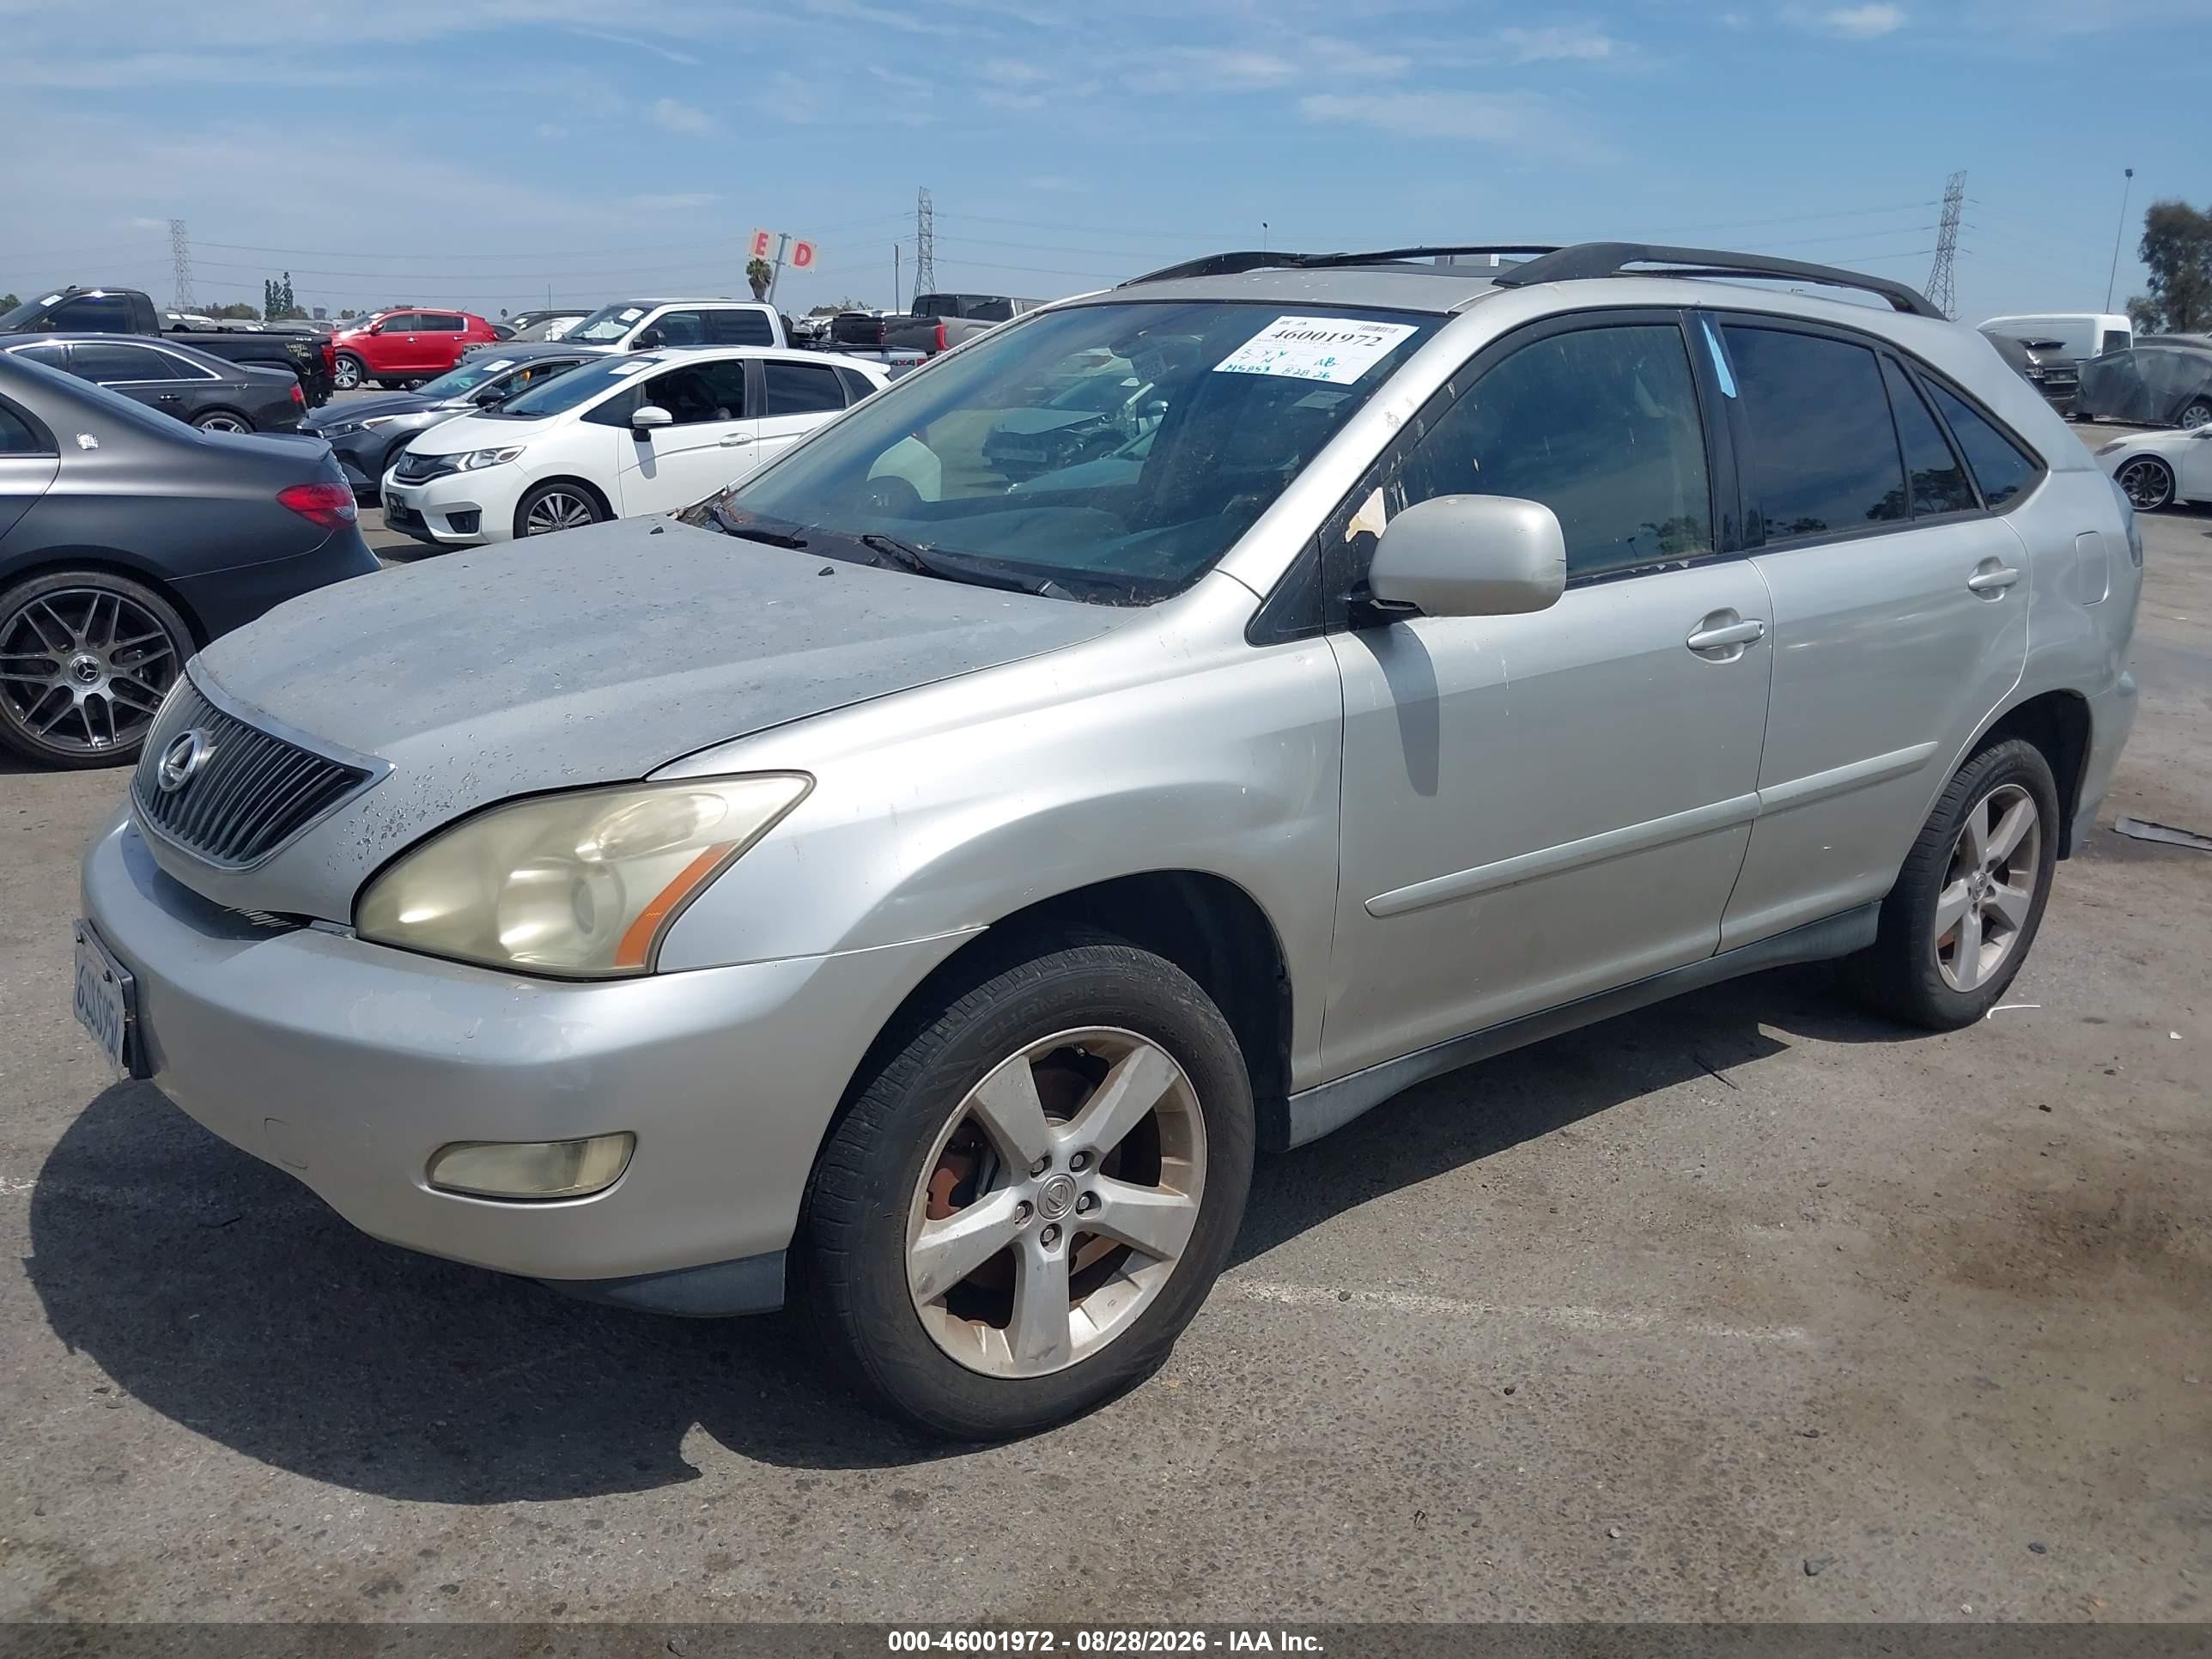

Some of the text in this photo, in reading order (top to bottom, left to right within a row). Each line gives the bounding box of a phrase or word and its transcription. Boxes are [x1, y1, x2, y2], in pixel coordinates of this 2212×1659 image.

[756, 233, 769, 256] E
[794, 243, 811, 266] D
[1271, 329, 1383, 347] 46001972
